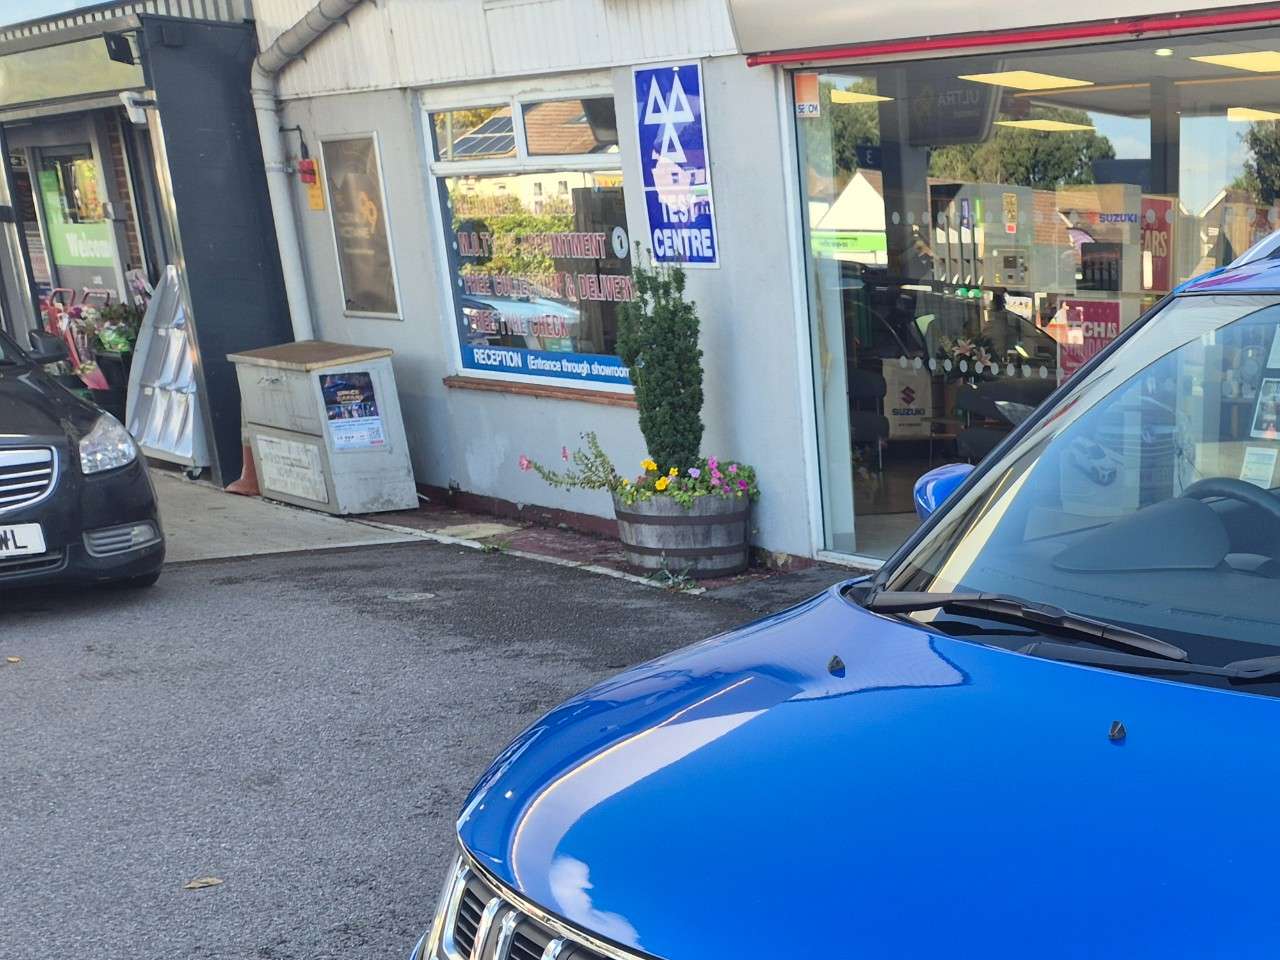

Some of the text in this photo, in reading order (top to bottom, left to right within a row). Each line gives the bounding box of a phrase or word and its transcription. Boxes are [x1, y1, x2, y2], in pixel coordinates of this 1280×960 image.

[1099, 213, 1138, 224] SUZUKI
[653, 228, 714, 257] CENTRE
[473, 348, 523, 368] RECEPTION
[561, 358, 591, 377] through
